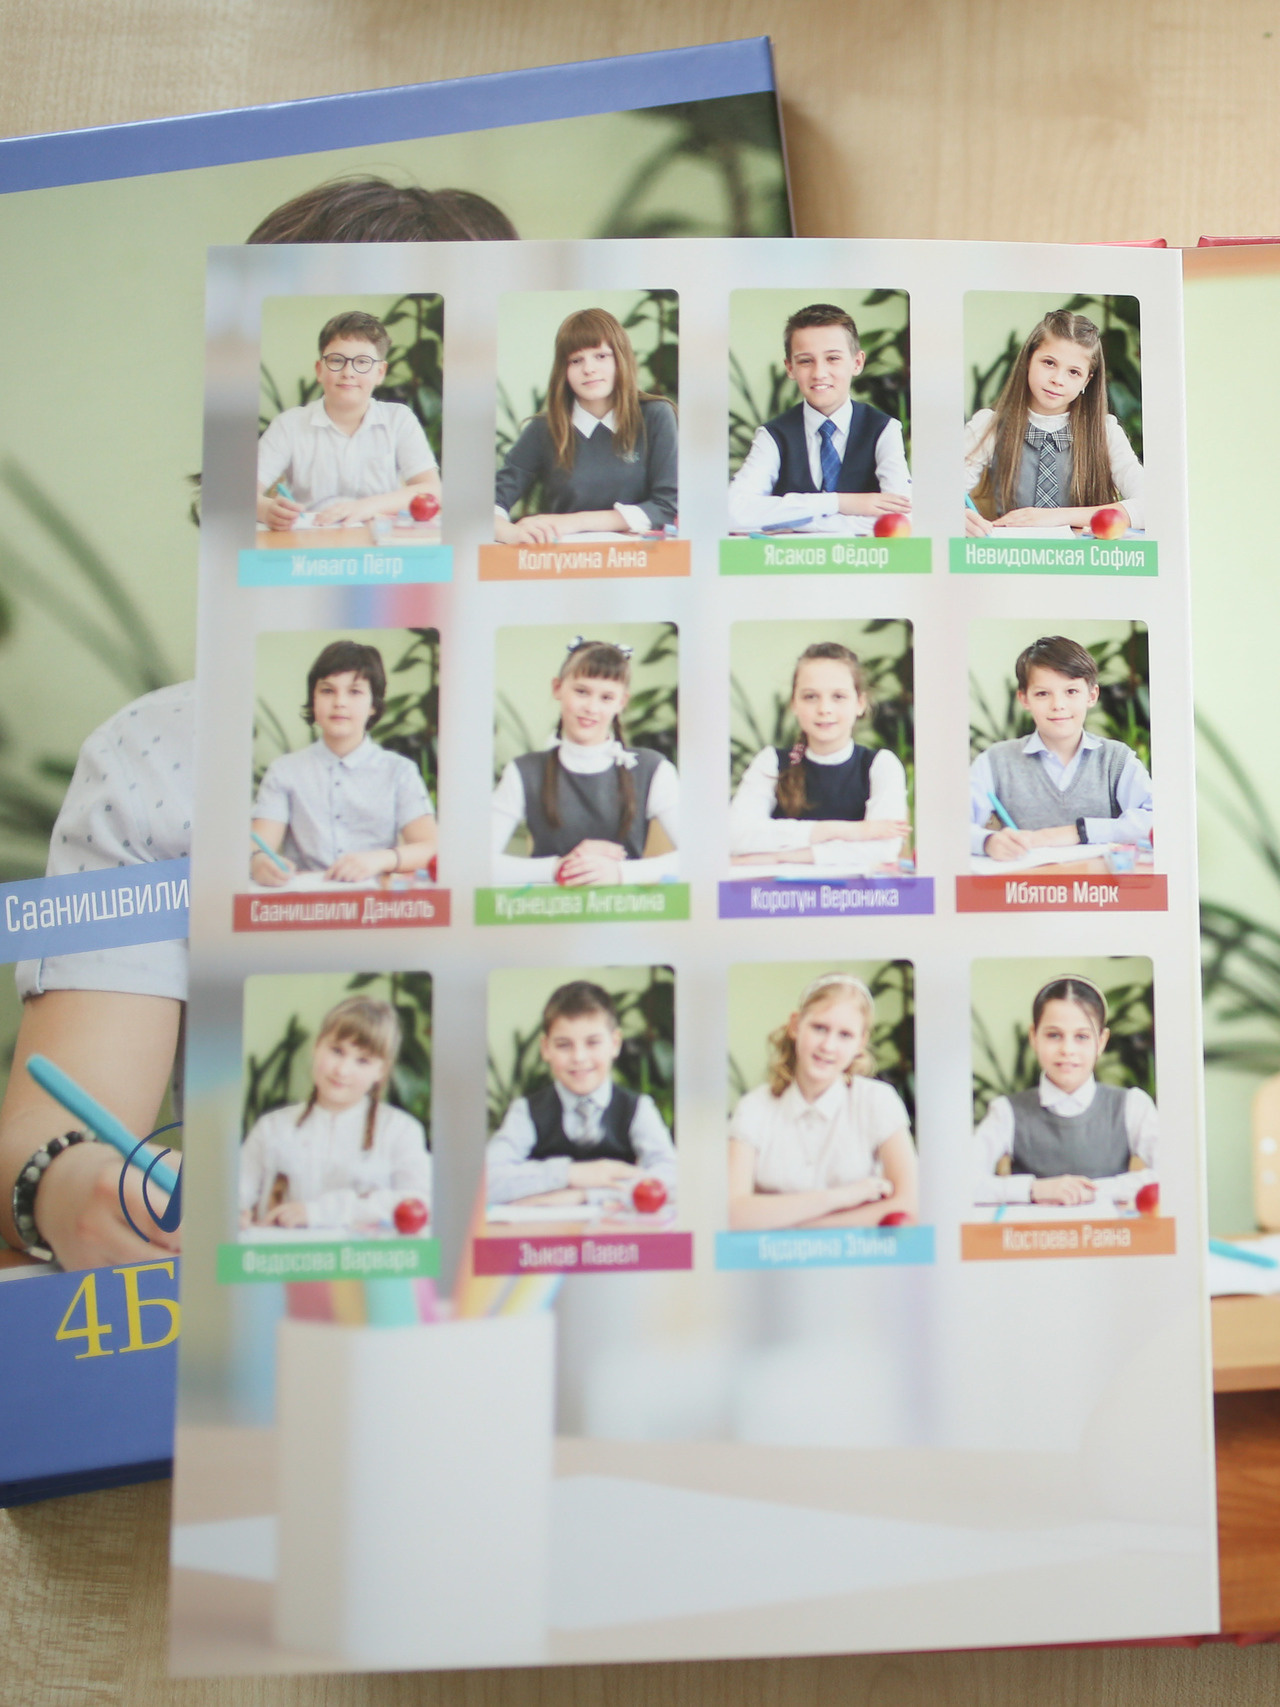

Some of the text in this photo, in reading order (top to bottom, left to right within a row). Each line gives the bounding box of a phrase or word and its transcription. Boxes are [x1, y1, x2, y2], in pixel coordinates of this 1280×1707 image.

[290, 552, 404, 578] Живаго Пётр
[607, 547, 647, 568] Анна
[764, 541, 889, 567] Ясаков Фёдор
[965, 543, 1145, 568] Невидомская София
[5, 878, 191, 933] Саанишвили
[751, 884, 899, 911] Коротун Вероника
[1005, 881, 1119, 904] Ибятов Марк
[250, 899, 357, 922] Саанишвили
[55, 1260, 182, 1360] 4Б
